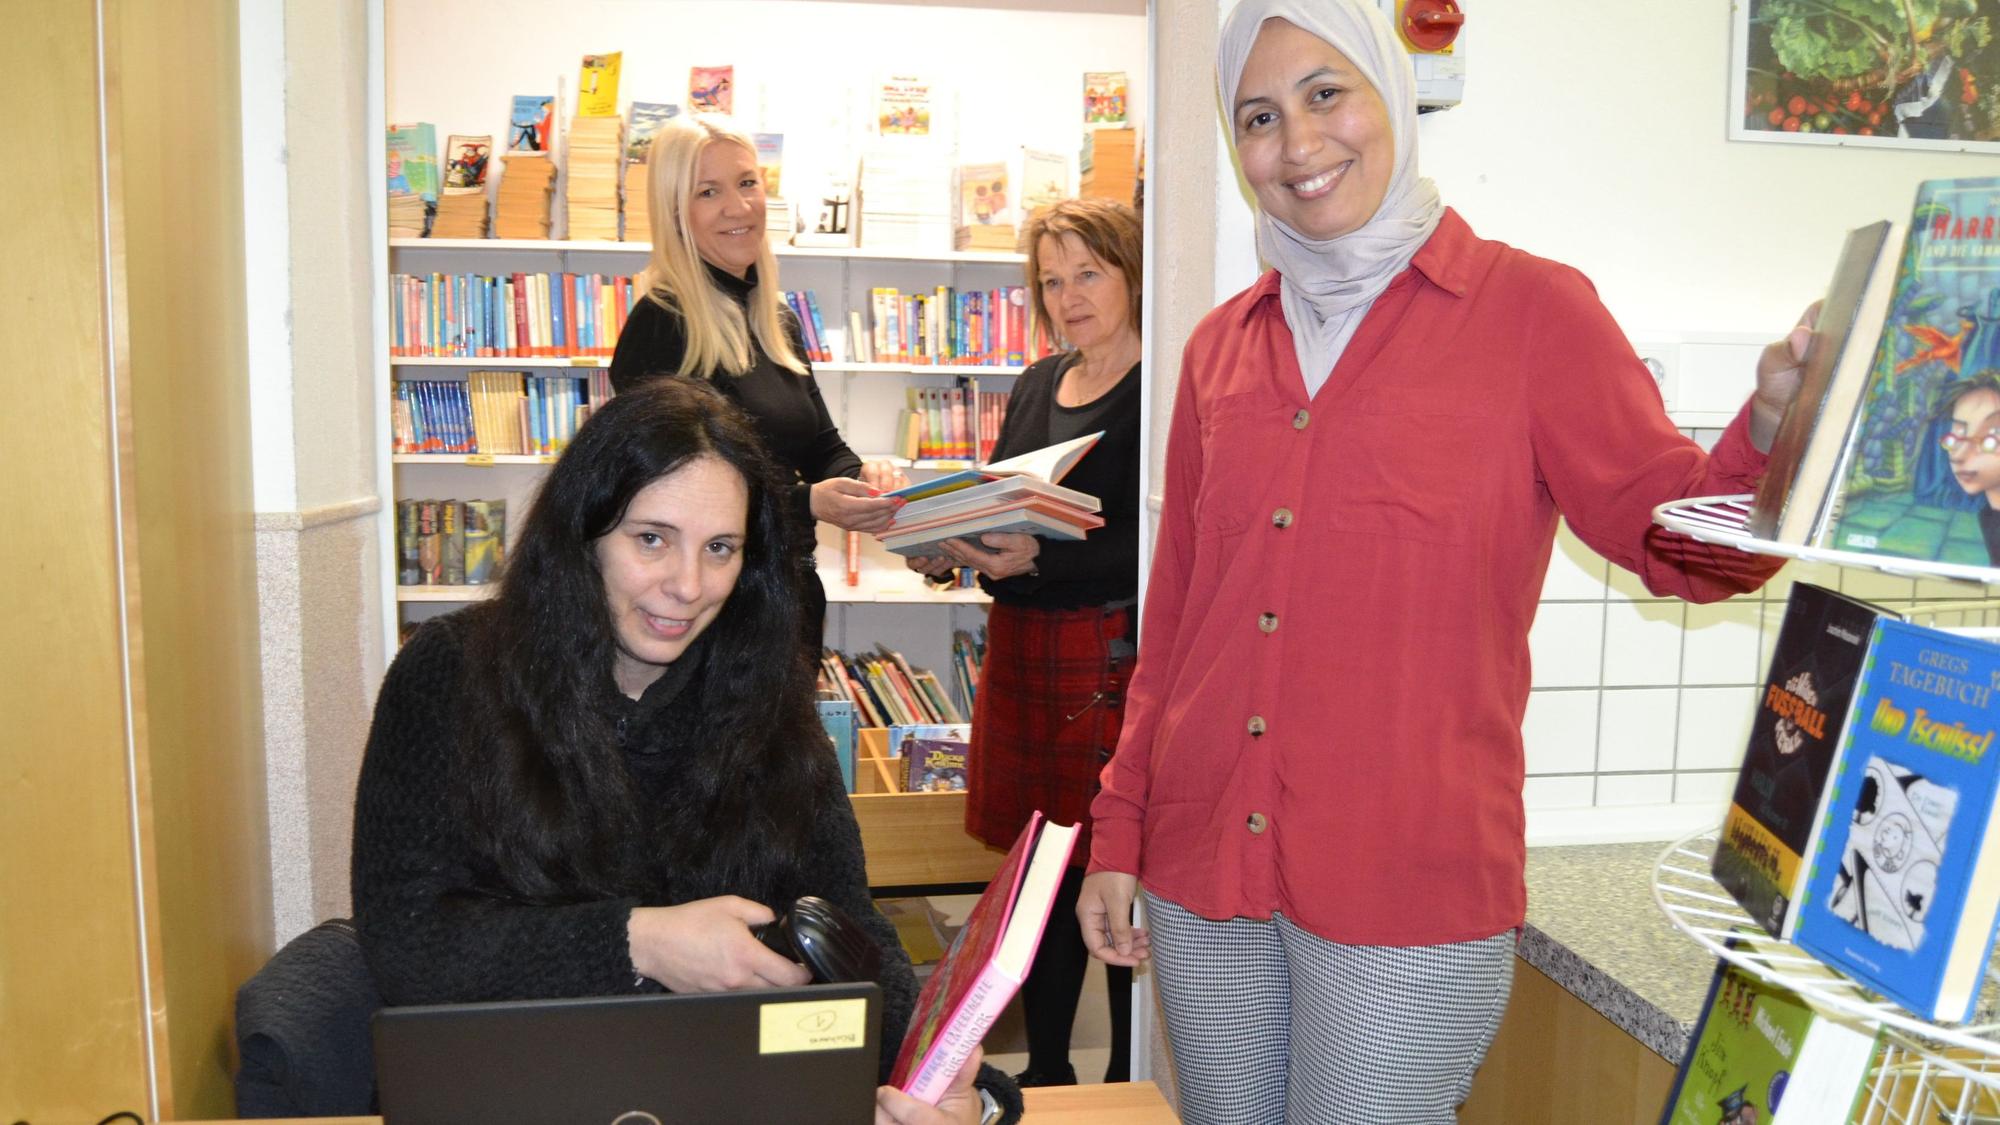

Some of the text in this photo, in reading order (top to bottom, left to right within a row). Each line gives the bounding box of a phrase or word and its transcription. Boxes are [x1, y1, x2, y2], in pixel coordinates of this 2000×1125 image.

[1932, 214, 2000, 240] HARR
[1919, 648, 1969, 674] GREGS
[1890, 660, 1992, 708] TAGEBUCH
[1765, 684, 1826, 739] FUSSBALL
